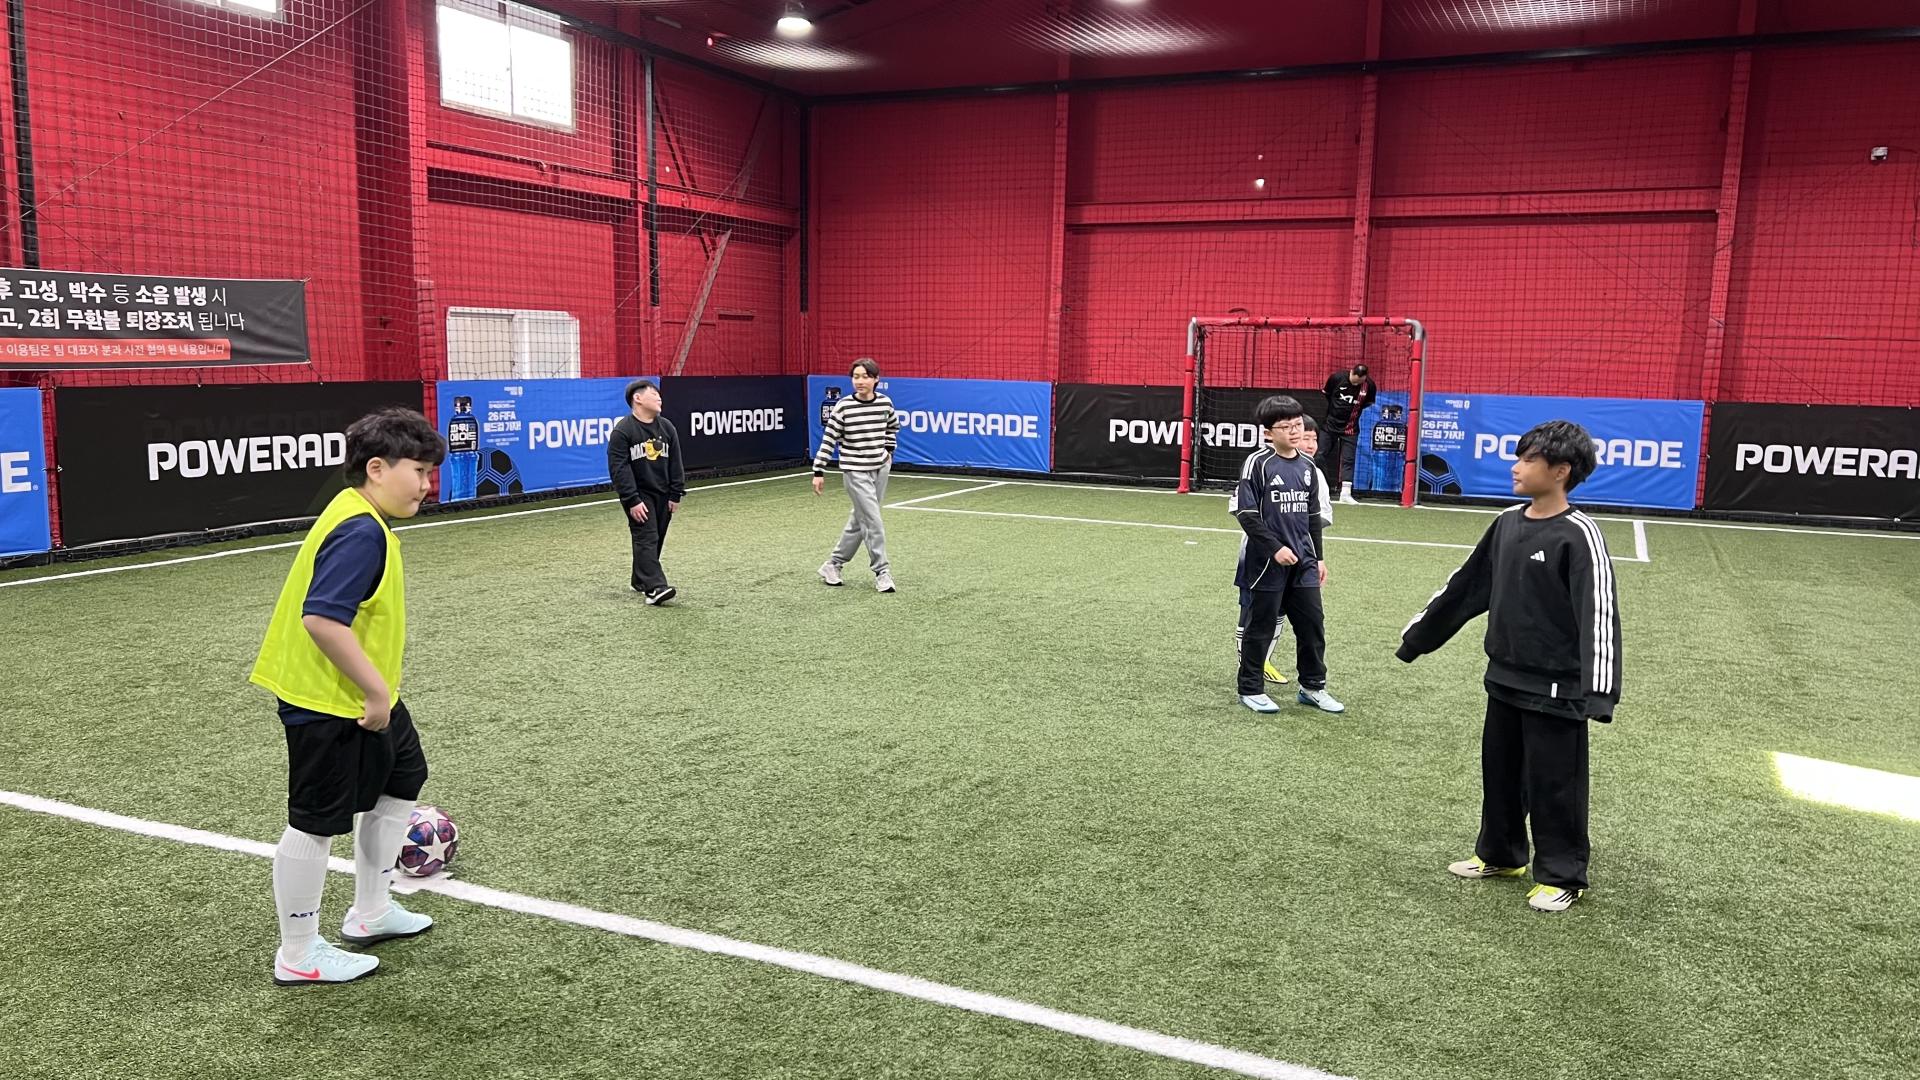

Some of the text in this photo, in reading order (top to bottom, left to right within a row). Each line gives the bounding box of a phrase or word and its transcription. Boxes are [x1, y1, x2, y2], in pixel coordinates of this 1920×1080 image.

[19, 280, 64, 303] 고성,
[68, 281, 107, 303] 박수
[112, 284, 130, 304] 등
[135, 285, 170, 305] 소음
[173, 285, 207, 306] 발생
[212, 287, 226, 307] 시
[0, 308, 245, 331] 고, 2회 무환불 퇴장조치 됩니다
[6, 344, 50, 357] 이용팀은
[53, 344, 64, 357] 팀
[68, 344, 98, 357] 대표자
[101, 344, 121, 357] 분과
[124, 344, 145, 357] 사전
[147, 344, 166, 357] 협의
[168, 344, 178, 356] 된
[180, 343, 225, 356] 내용입니다
[488, 411, 517, 421] 26 FIFA
[691, 408, 784, 437] POWERADE
[1422, 420, 1459, 430] 26 FIFA
[1735, 443, 1920, 479] POWERA
